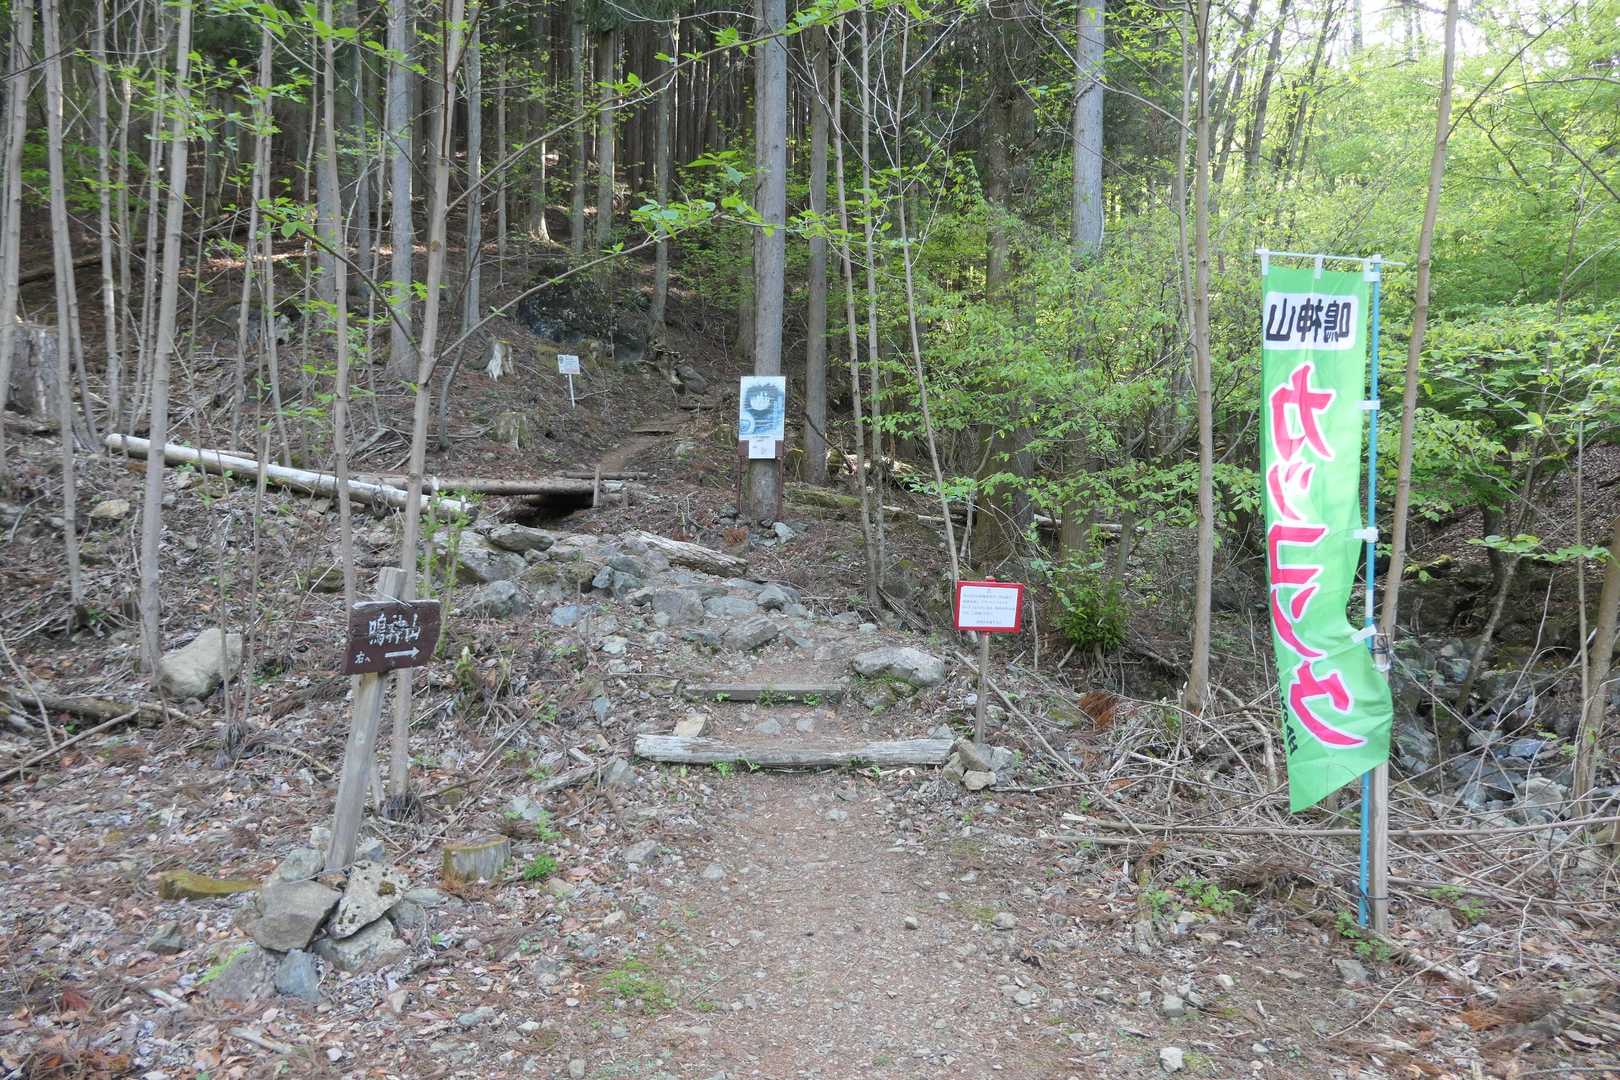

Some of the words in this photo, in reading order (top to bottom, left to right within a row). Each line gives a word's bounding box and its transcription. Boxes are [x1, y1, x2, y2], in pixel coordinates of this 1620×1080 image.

[368, 613, 421, 646] 鳴神山
[354, 650, 371, 664] 右へ
